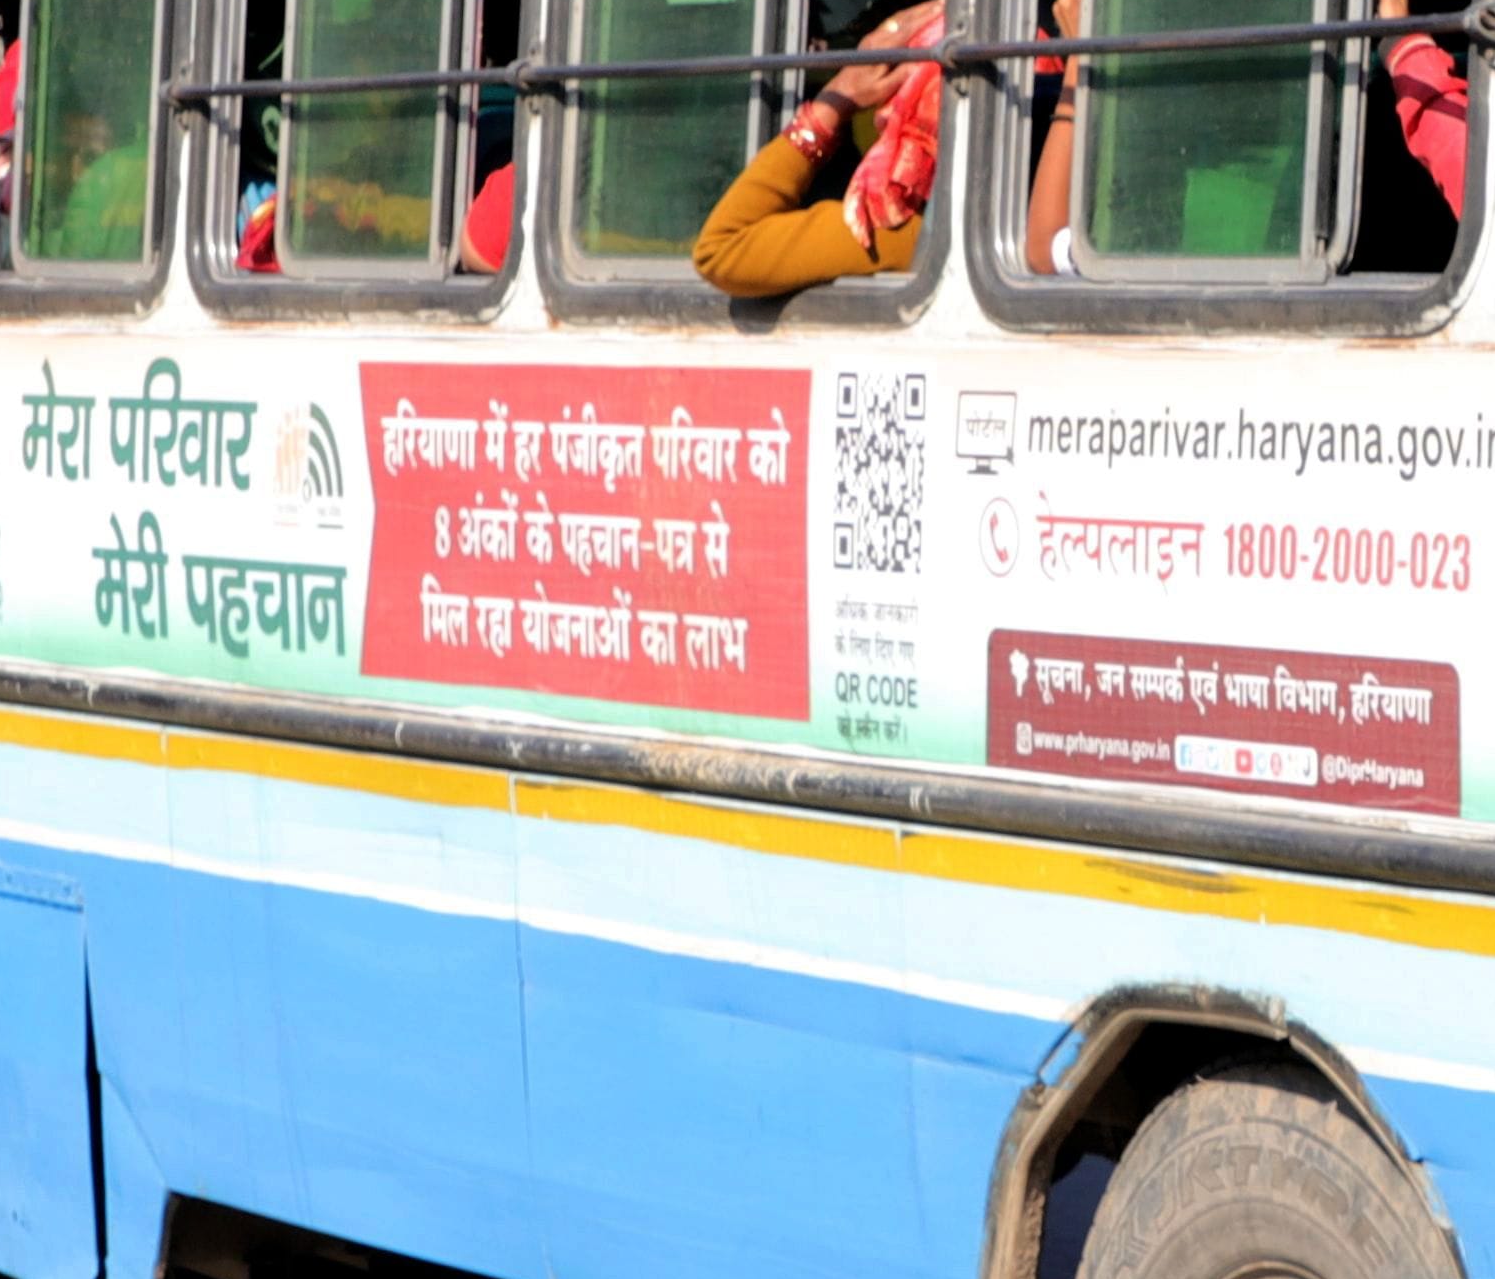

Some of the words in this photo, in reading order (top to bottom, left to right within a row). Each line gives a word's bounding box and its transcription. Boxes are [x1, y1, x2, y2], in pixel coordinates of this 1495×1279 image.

[22, 356, 96, 481] मेरा
[108, 356, 258, 491] परिवार
[380, 398, 478, 476] हरियाणा
[481, 398, 508, 473] में
[511, 420, 545, 482] हर
[549, 402, 646, 493] पंजीकृत
[650, 405, 743, 482] परिवार
[745, 407, 792, 486] को
[434, 503, 452, 558] 8
[456, 488, 519, 561] अंकों
[523, 491, 554, 564] के
[558, 511, 696, 576] पहचान-पत्र
[700, 499, 731, 579] से
[1035, 490, 1206, 595] हेल्पलाइन
[1222, 521, 1472, 593] 1800-2000-023
[91, 510, 169, 640] मेरी
[181, 554, 348, 659] पहचान
[419, 573, 472, 647] मिल
[473, 593, 514, 657] रहा
[519, 580, 632, 662] योजनाओं
[637, 608, 678, 669] का
[680, 613, 749, 674] लाभ
[835, 671, 862, 704] QR
[866, 673, 919, 709] CODE
[1033, 658, 1092, 706] सूचना,
[1094, 661, 1126, 698] जन
[1128, 655, 1185, 703] सम्पर्क
[1187, 661, 1219, 716] एवं
[1223, 673, 1271, 711] भाषा
[1273, 664, 1347, 726] विभाग,
[1349, 672, 1434, 726] हरियाणा
[1032, 730, 1171, 765] www.prharyana.gov.in
